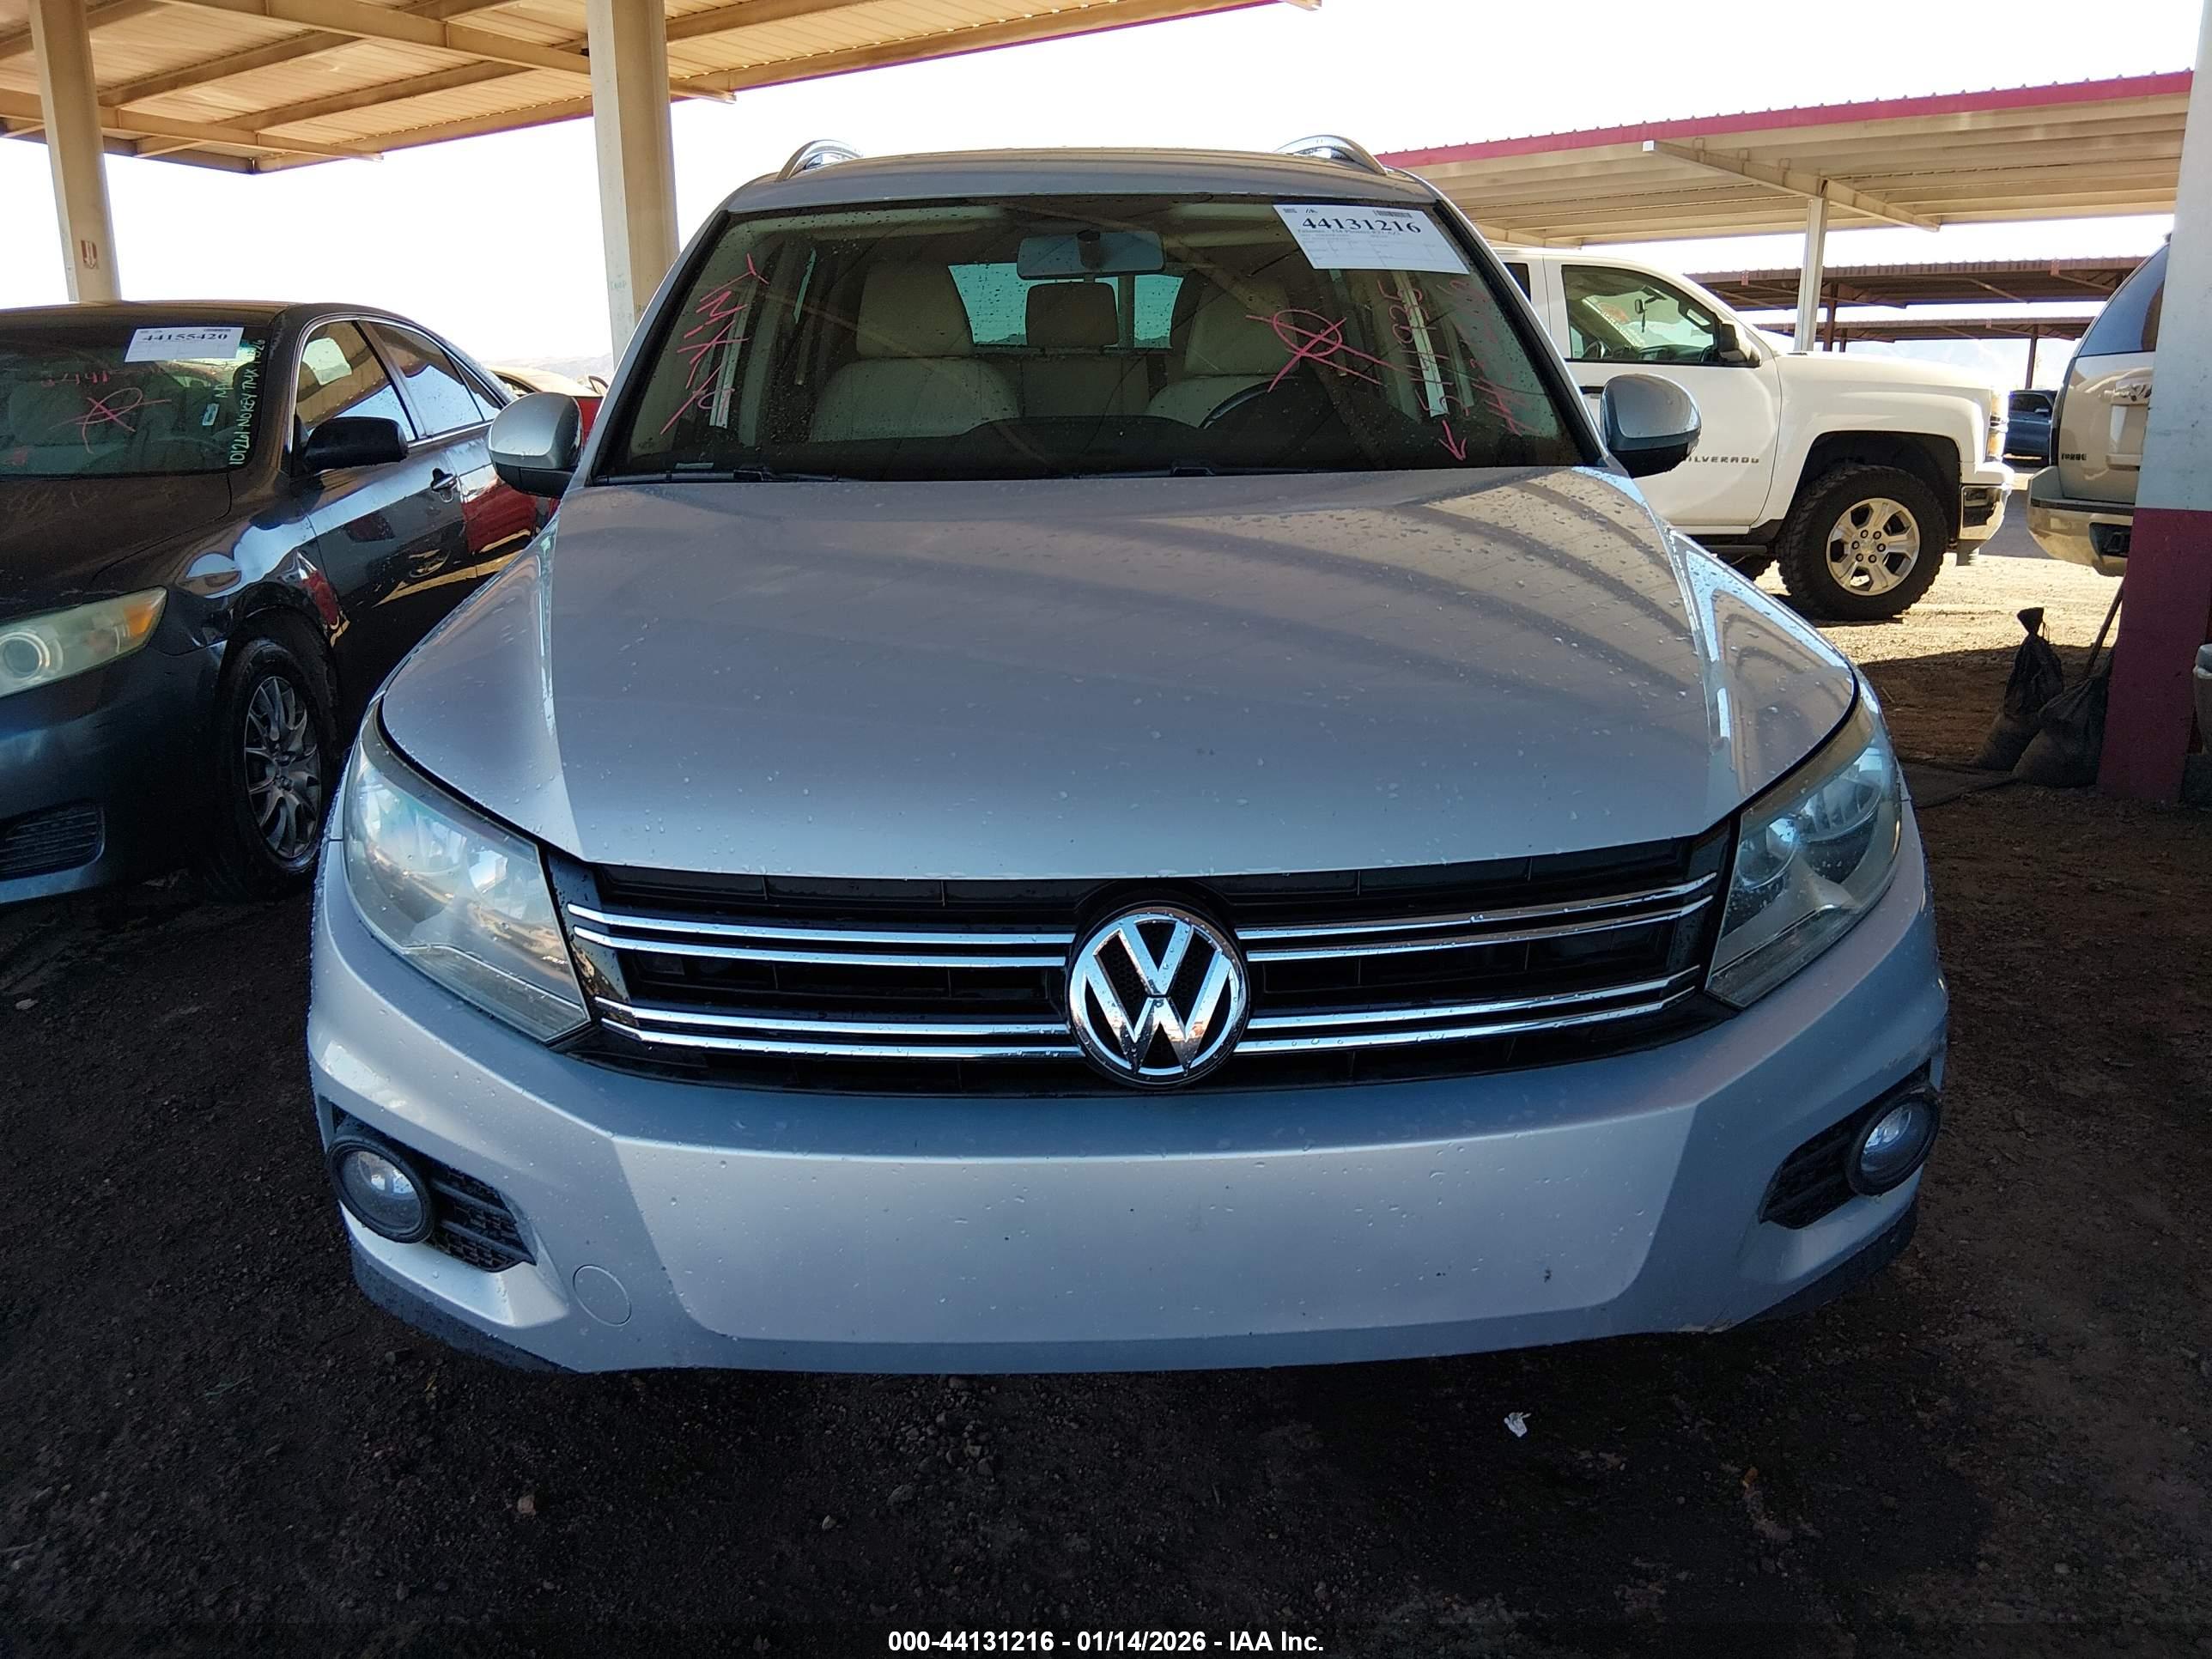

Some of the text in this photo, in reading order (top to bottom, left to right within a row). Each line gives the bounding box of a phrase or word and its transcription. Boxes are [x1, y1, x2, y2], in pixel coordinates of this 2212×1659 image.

[1302, 218, 1422, 234] 44131216
[143, 333, 228, 342] 44155420
[1688, 455, 1759, 464] ILVERADO
[1071, 908, 1246, 1084] VW
